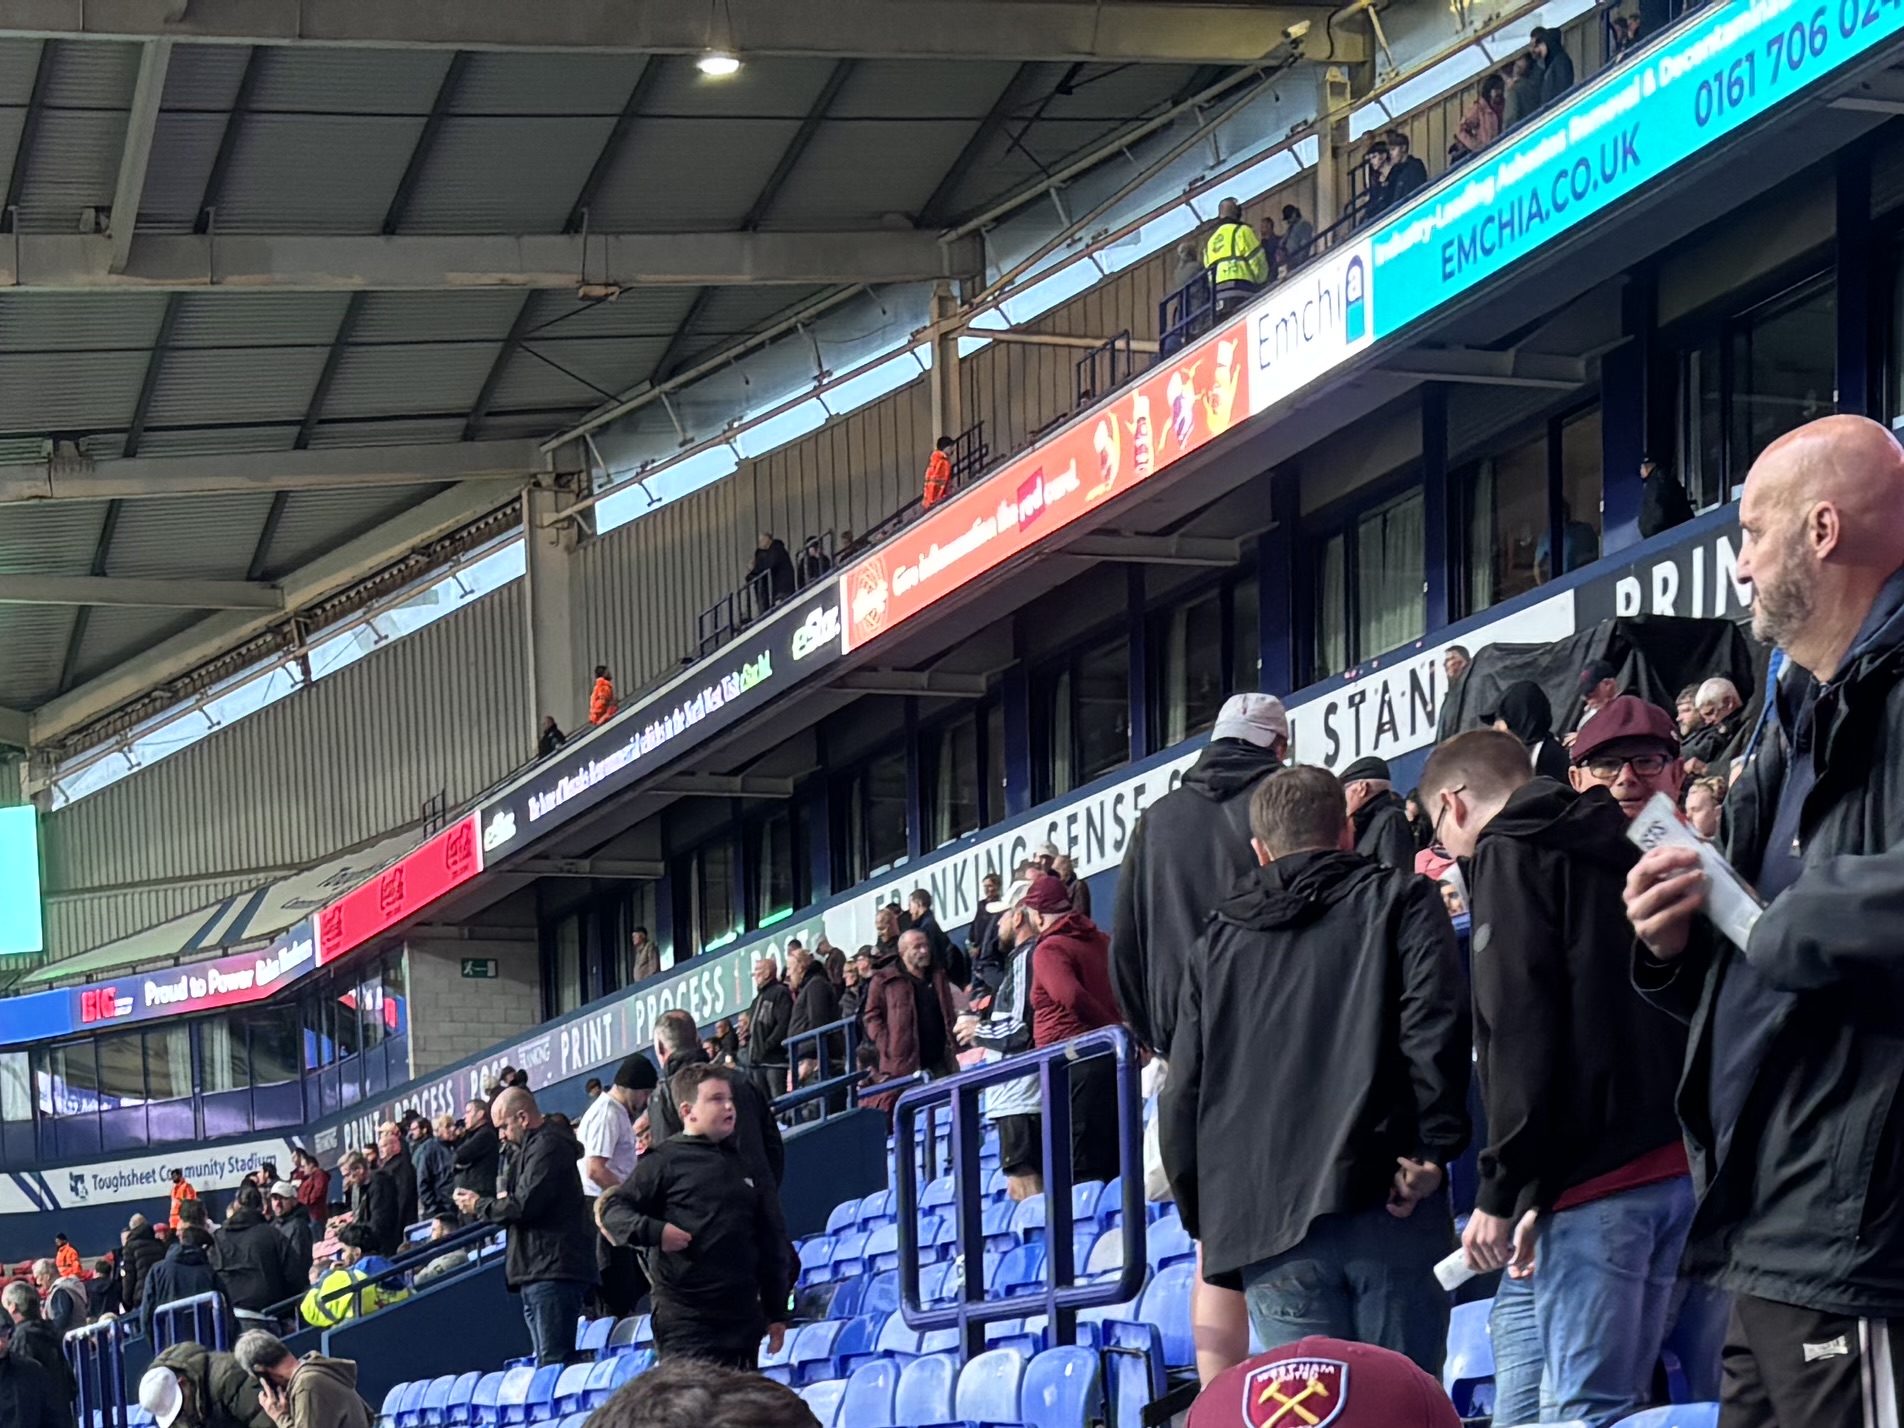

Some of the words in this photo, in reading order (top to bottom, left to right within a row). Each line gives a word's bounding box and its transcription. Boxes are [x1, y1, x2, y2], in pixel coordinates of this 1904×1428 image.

[1695, 50, 1756, 128] 0161
[1766, 6, 1828, 86] 706
[1441, 123, 1642, 283] EMCHIA.CO.UK
[1615, 529, 1753, 620] PRIN
[1323, 660, 1436, 768] STAN
[144, 974, 189, 1007] Proud
[189, 977, 207, 998] to
[208, 968, 255, 996] Power
[560, 1011, 613, 1075] PRINT
[91, 1167, 157, 1193] Toughsheet
[159, 1156, 226, 1184] Comunity
[228, 1150, 278, 1173] Stadium
